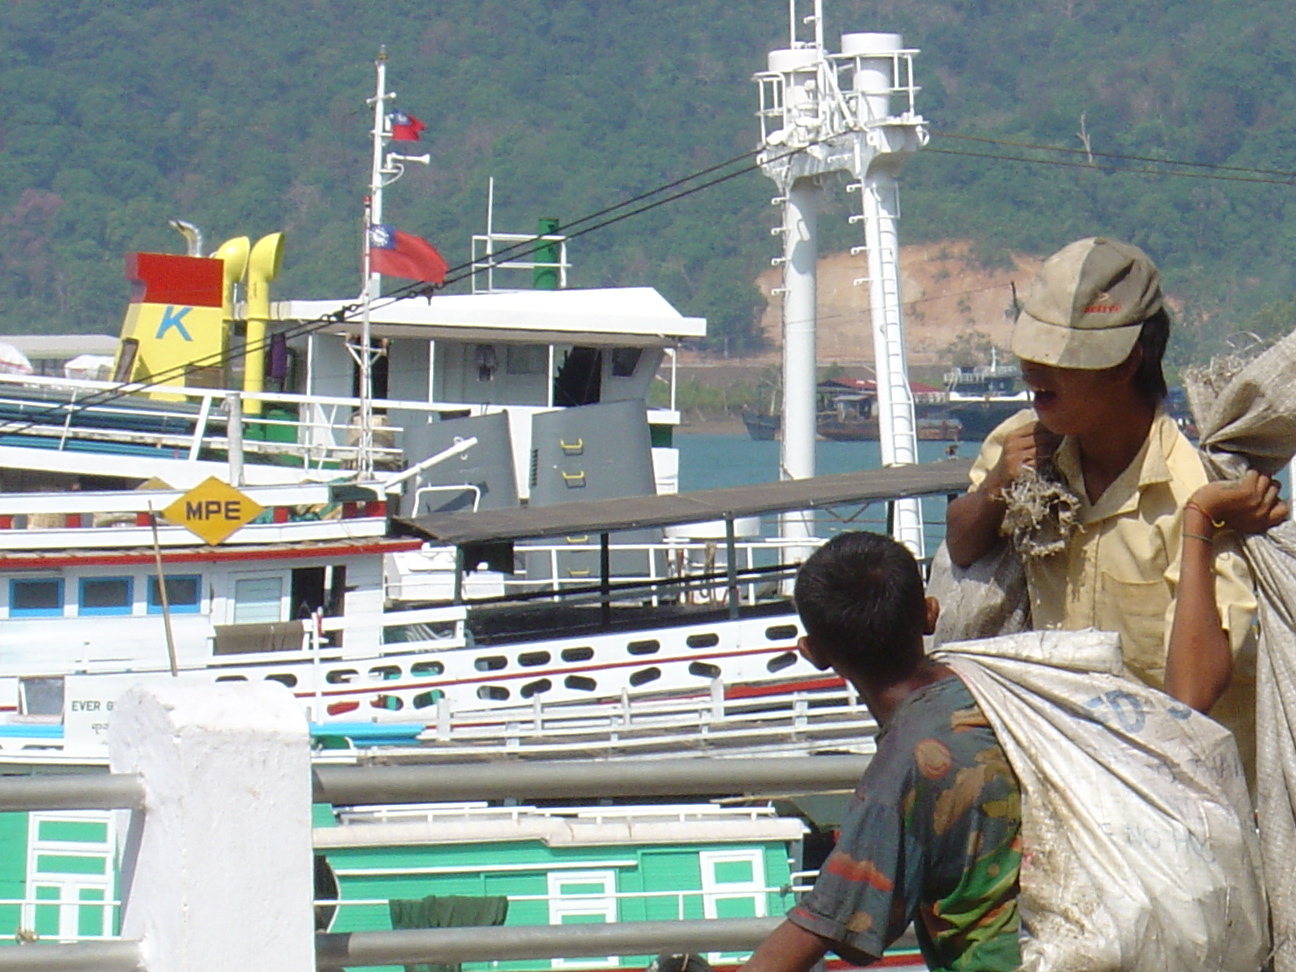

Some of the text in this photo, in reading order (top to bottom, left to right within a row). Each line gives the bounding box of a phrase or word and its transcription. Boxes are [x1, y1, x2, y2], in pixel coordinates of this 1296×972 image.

[155, 306, 193, 342] K
[186, 501, 241, 521] MPE
[71, 701, 116, 711] EVER G
